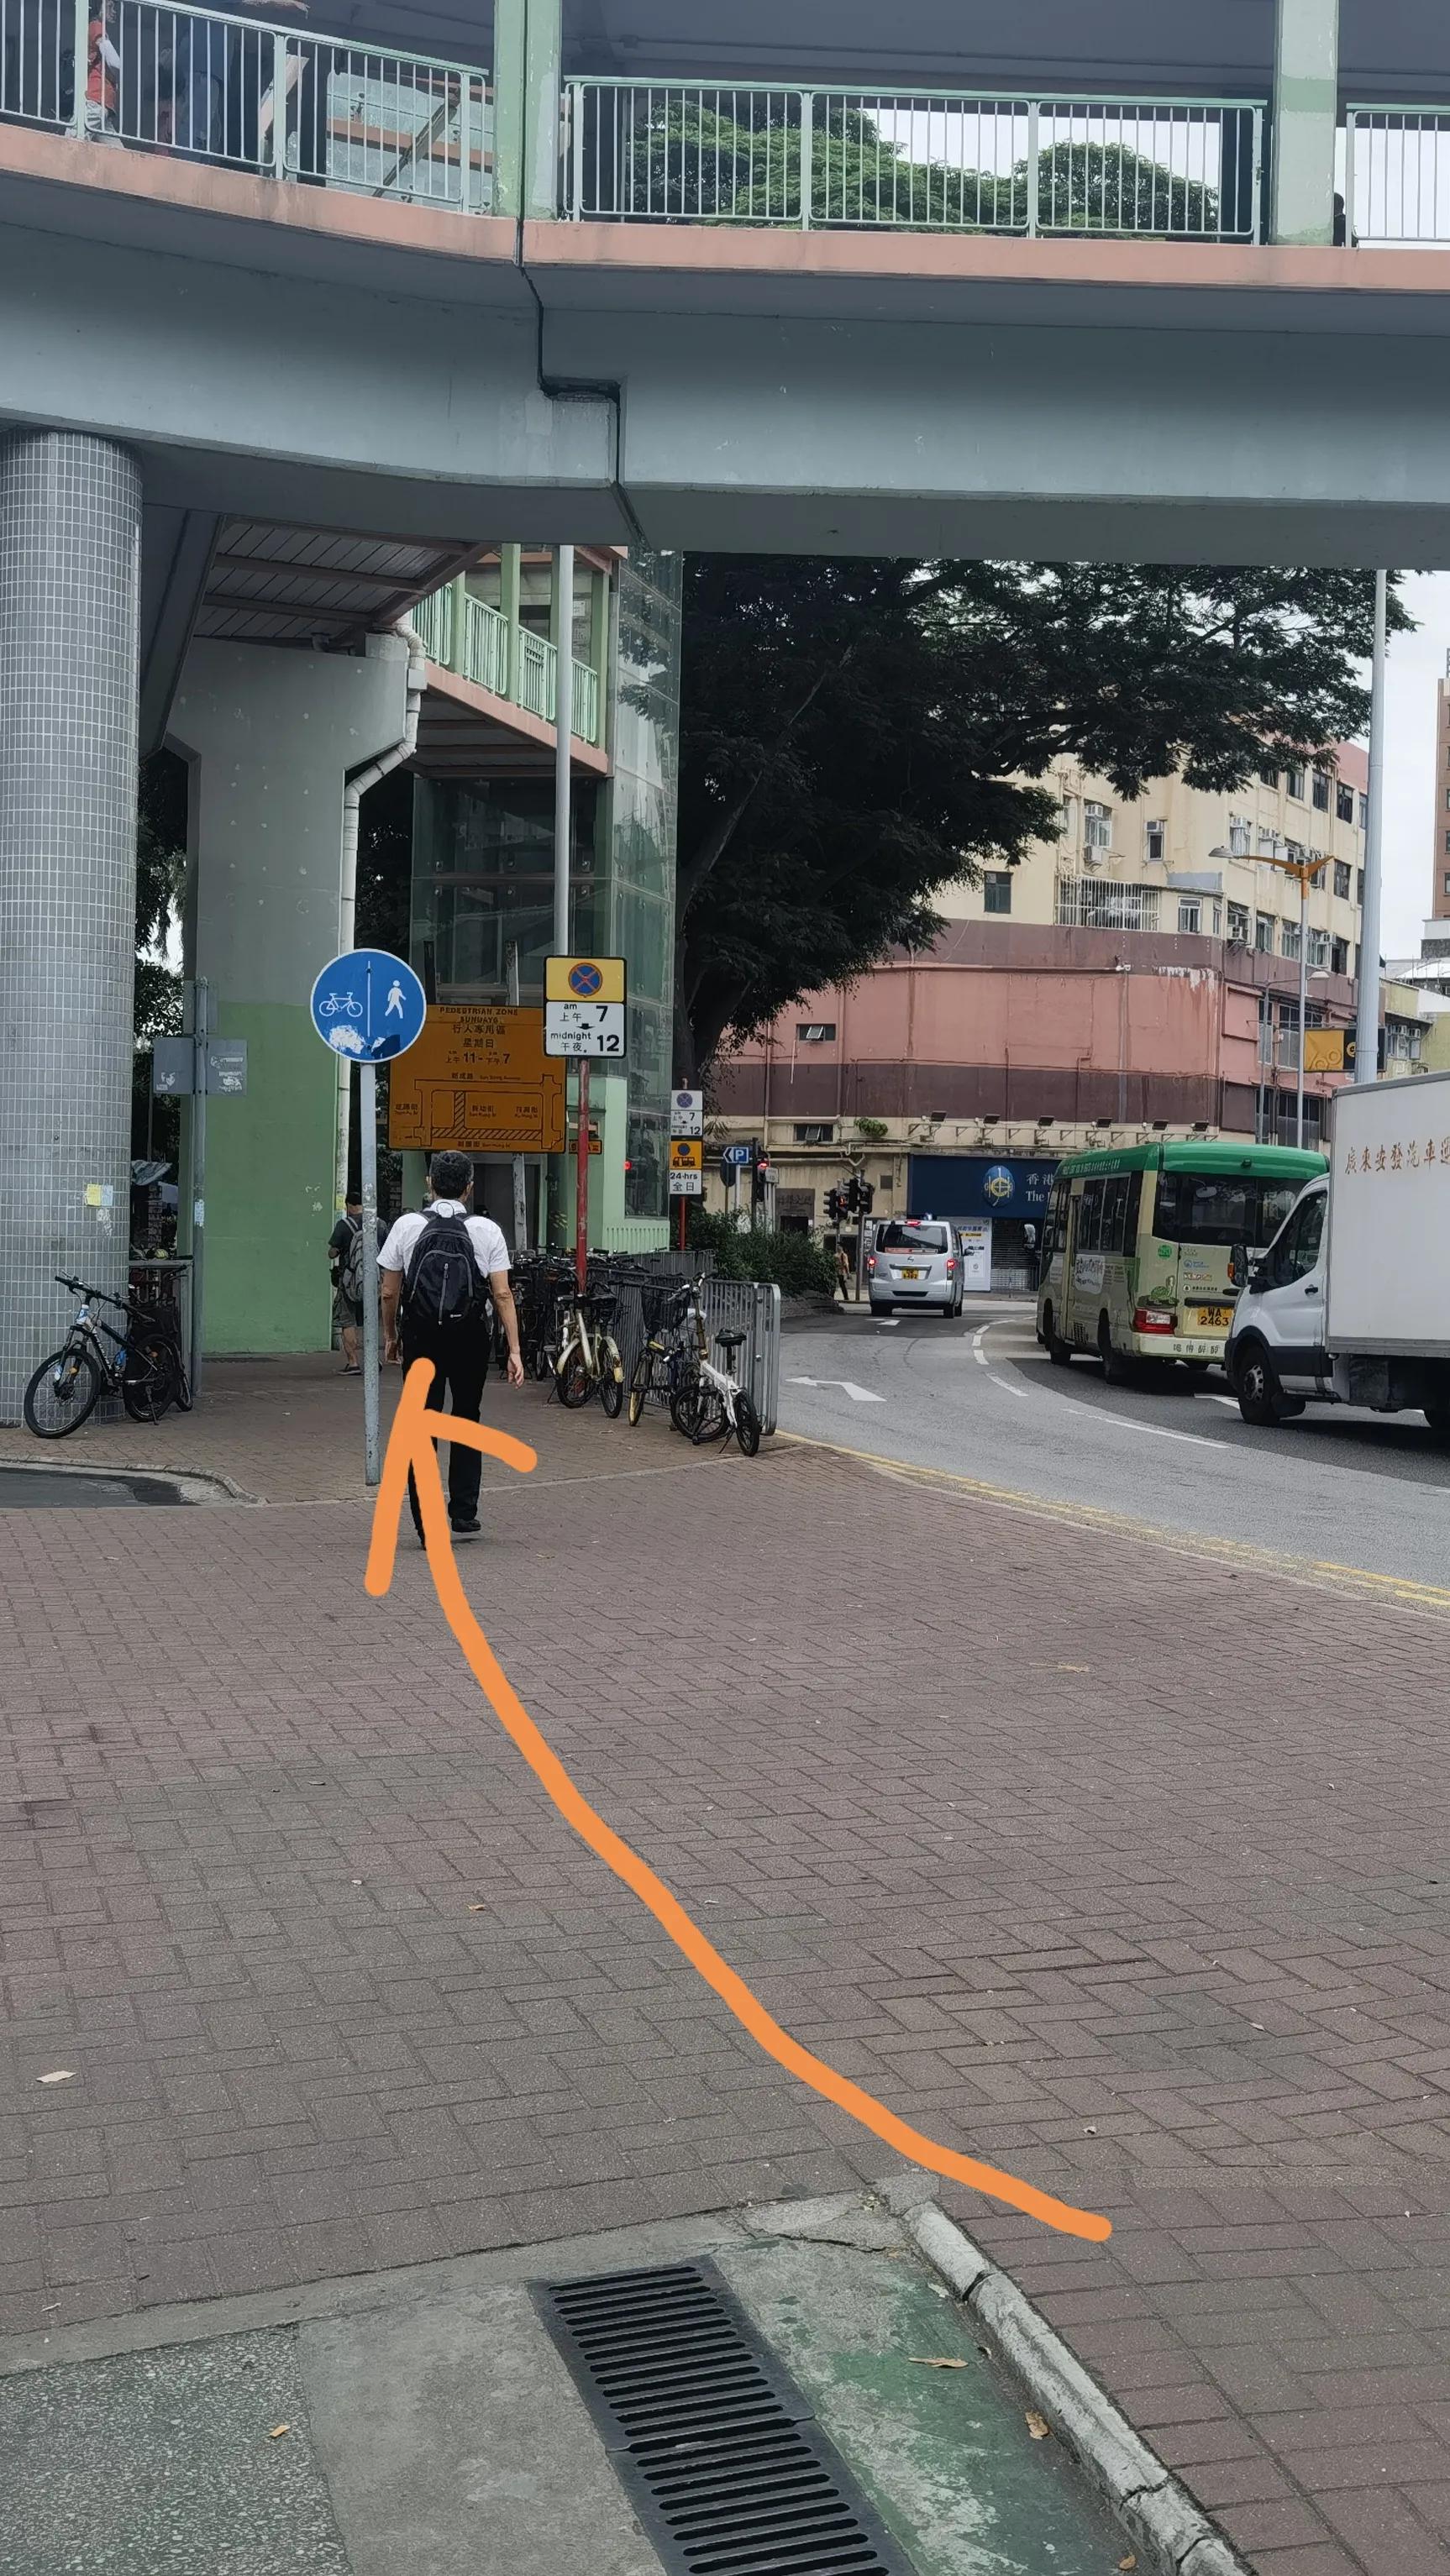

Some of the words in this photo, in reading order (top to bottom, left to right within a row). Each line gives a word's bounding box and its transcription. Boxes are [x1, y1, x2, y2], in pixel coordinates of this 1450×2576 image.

[560, 1012, 581, 1022] 上午
[596, 1005, 608, 1022] 7
[550, 1031, 591, 1041] midnight
[560, 1042, 582, 1052] 午夜
[596, 1034, 619, 1052] 12
[464, 1053, 475, 1063] 11
[502, 1053, 511, 1064] 7
[690, 1112, 696, 1121] 7
[690, 1126, 701, 1135] 12
[735, 1149, 744, 1161] P
[673, 1182, 694, 1192] 全日
[1026, 1190, 1045, 1203] The
[1208, 1307, 1222, 1318] WA
[1200, 1316, 1229, 1326] 2463
